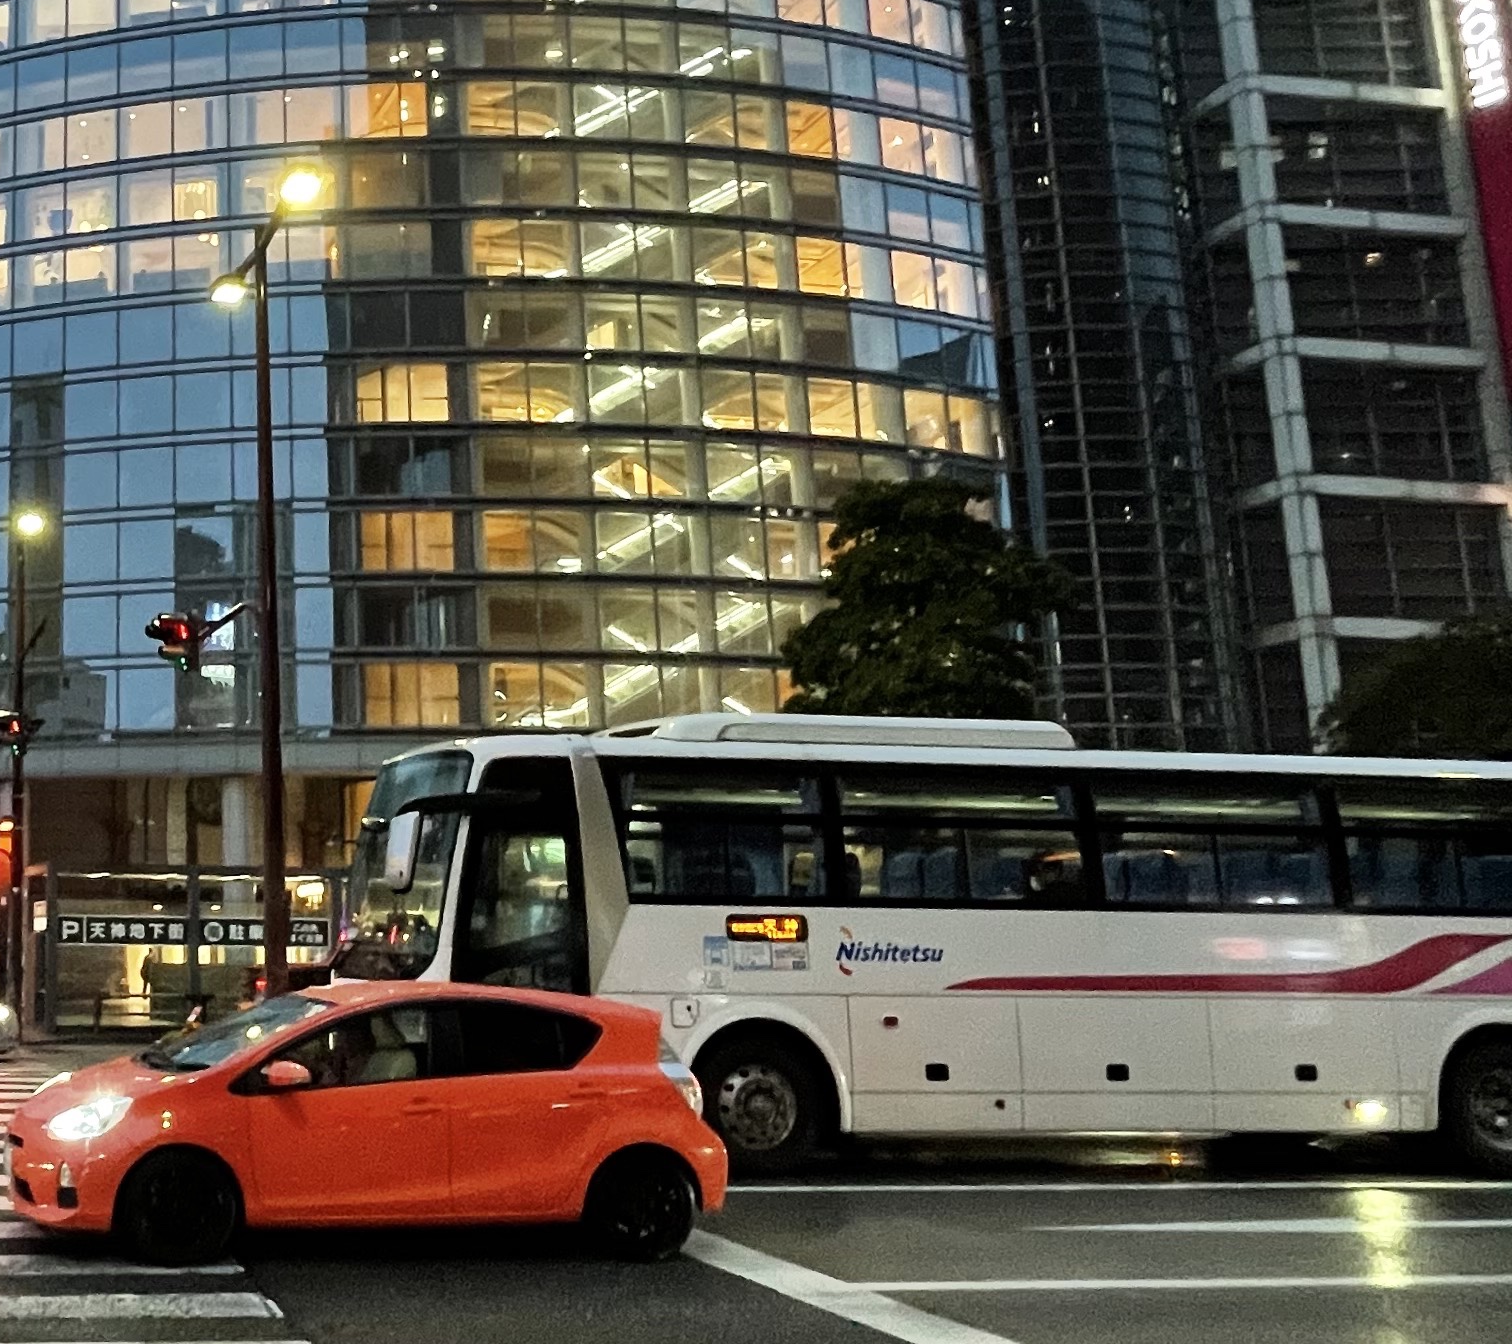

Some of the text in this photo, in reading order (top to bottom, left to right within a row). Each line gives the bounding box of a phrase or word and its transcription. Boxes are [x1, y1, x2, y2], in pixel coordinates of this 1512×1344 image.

[61, 920, 81, 941] P
[89, 921, 185, 941] 天神地下街
[835, 941, 945, 963] Nishitetsu
